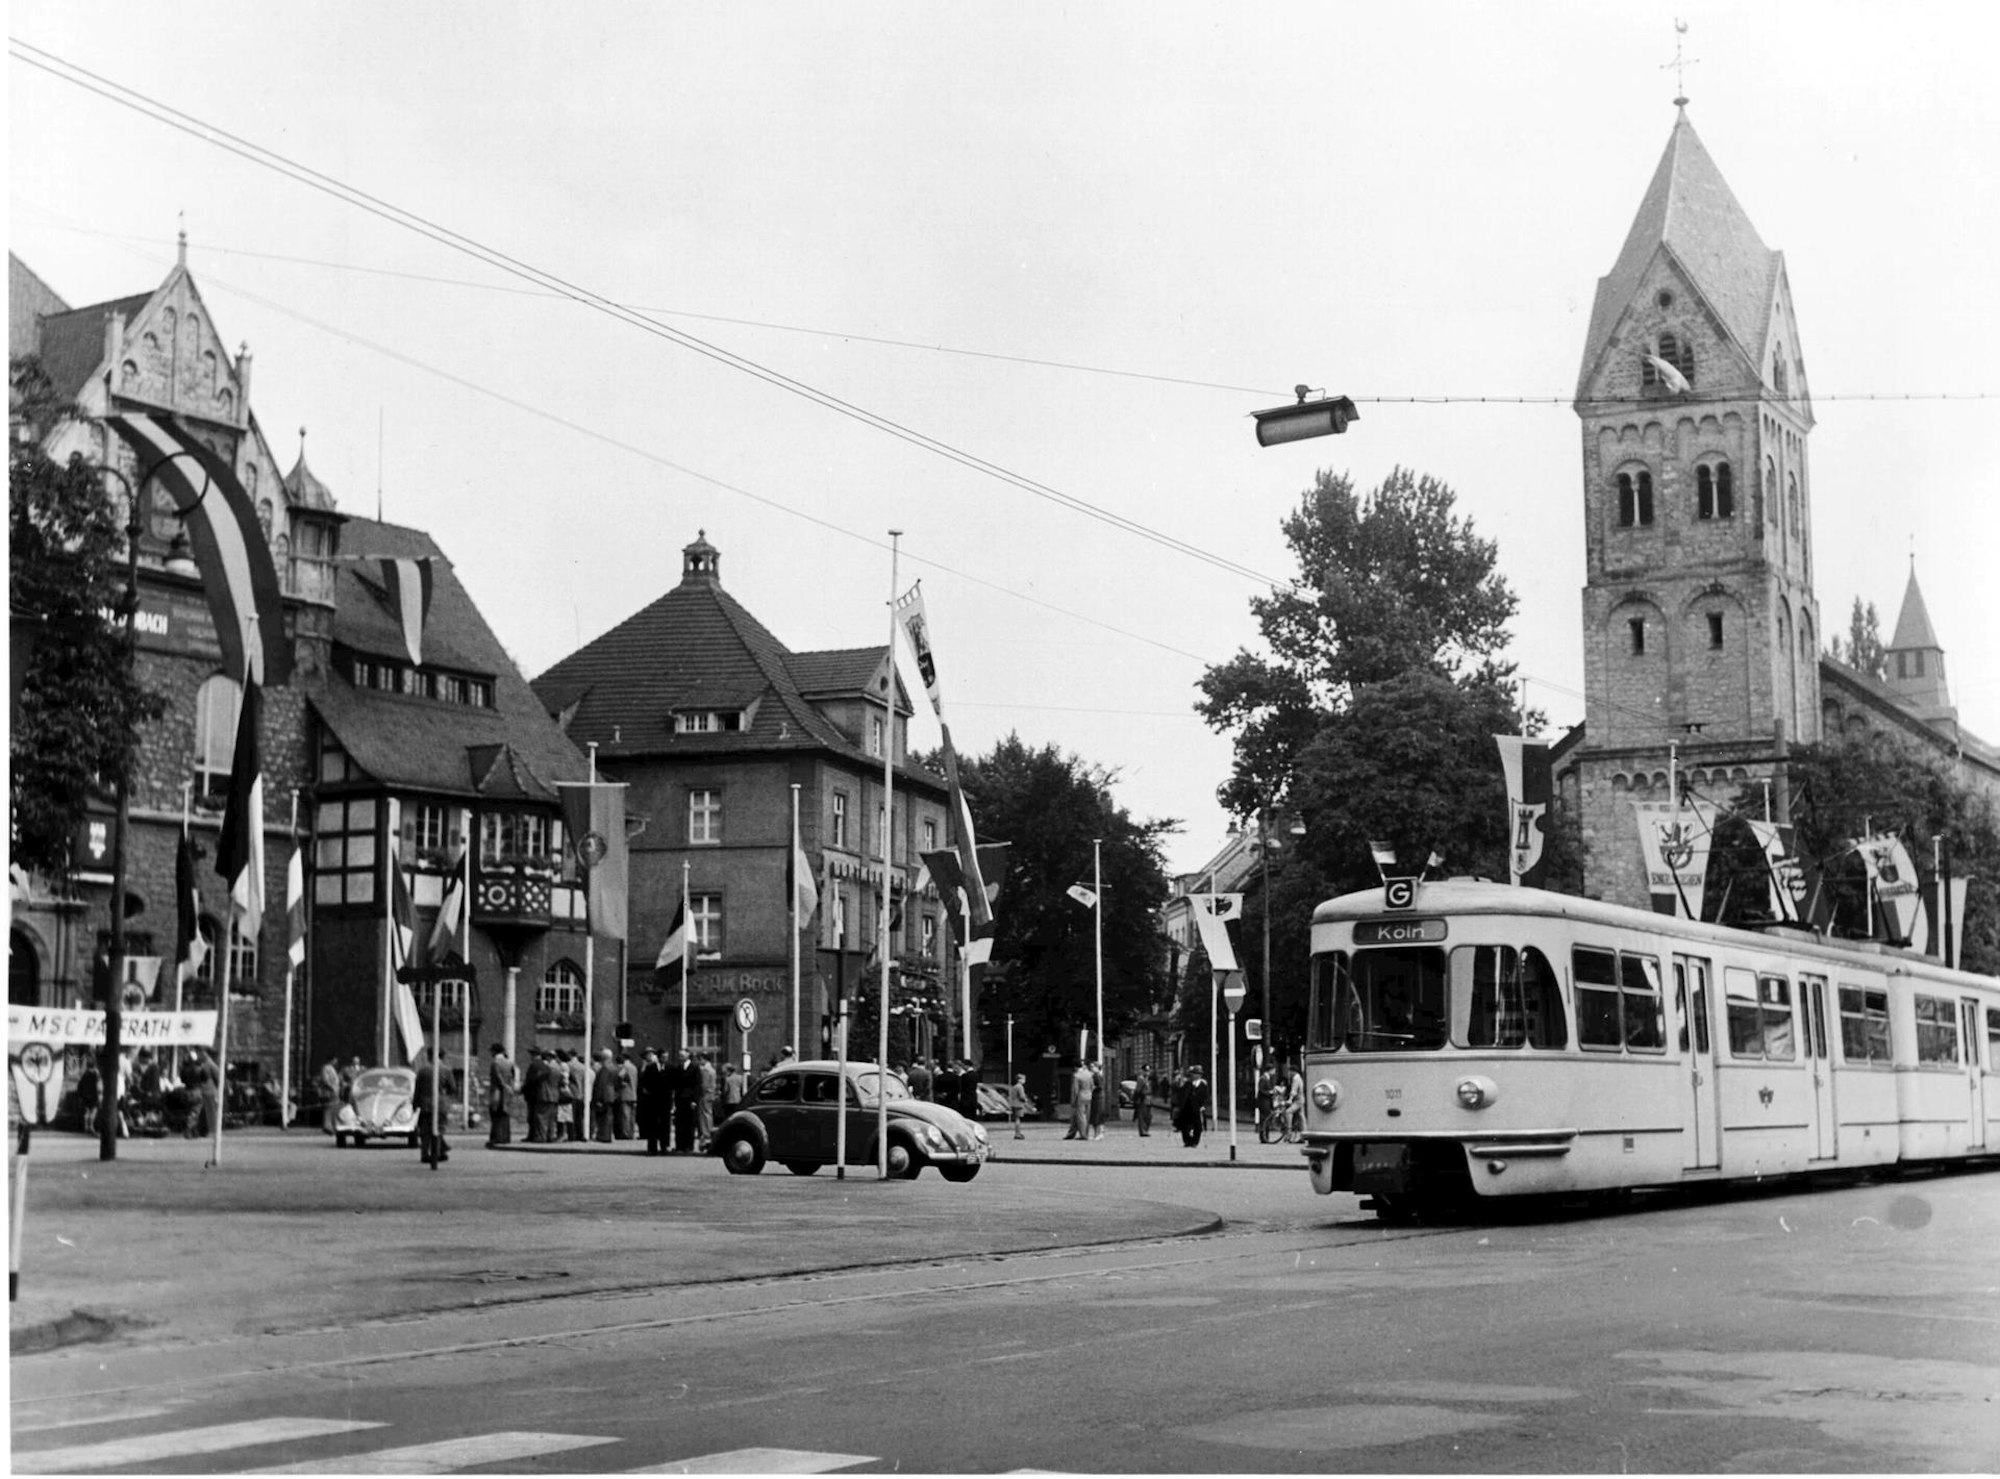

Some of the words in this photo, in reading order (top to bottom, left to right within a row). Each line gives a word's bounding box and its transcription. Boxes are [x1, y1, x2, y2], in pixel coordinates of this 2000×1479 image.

[1388, 882, 1411, 905] G
[1377, 925, 1426, 941] Köln
[28, 1014, 78, 1037] MSC
[84, 1016, 172, 1038] PAFRATH
